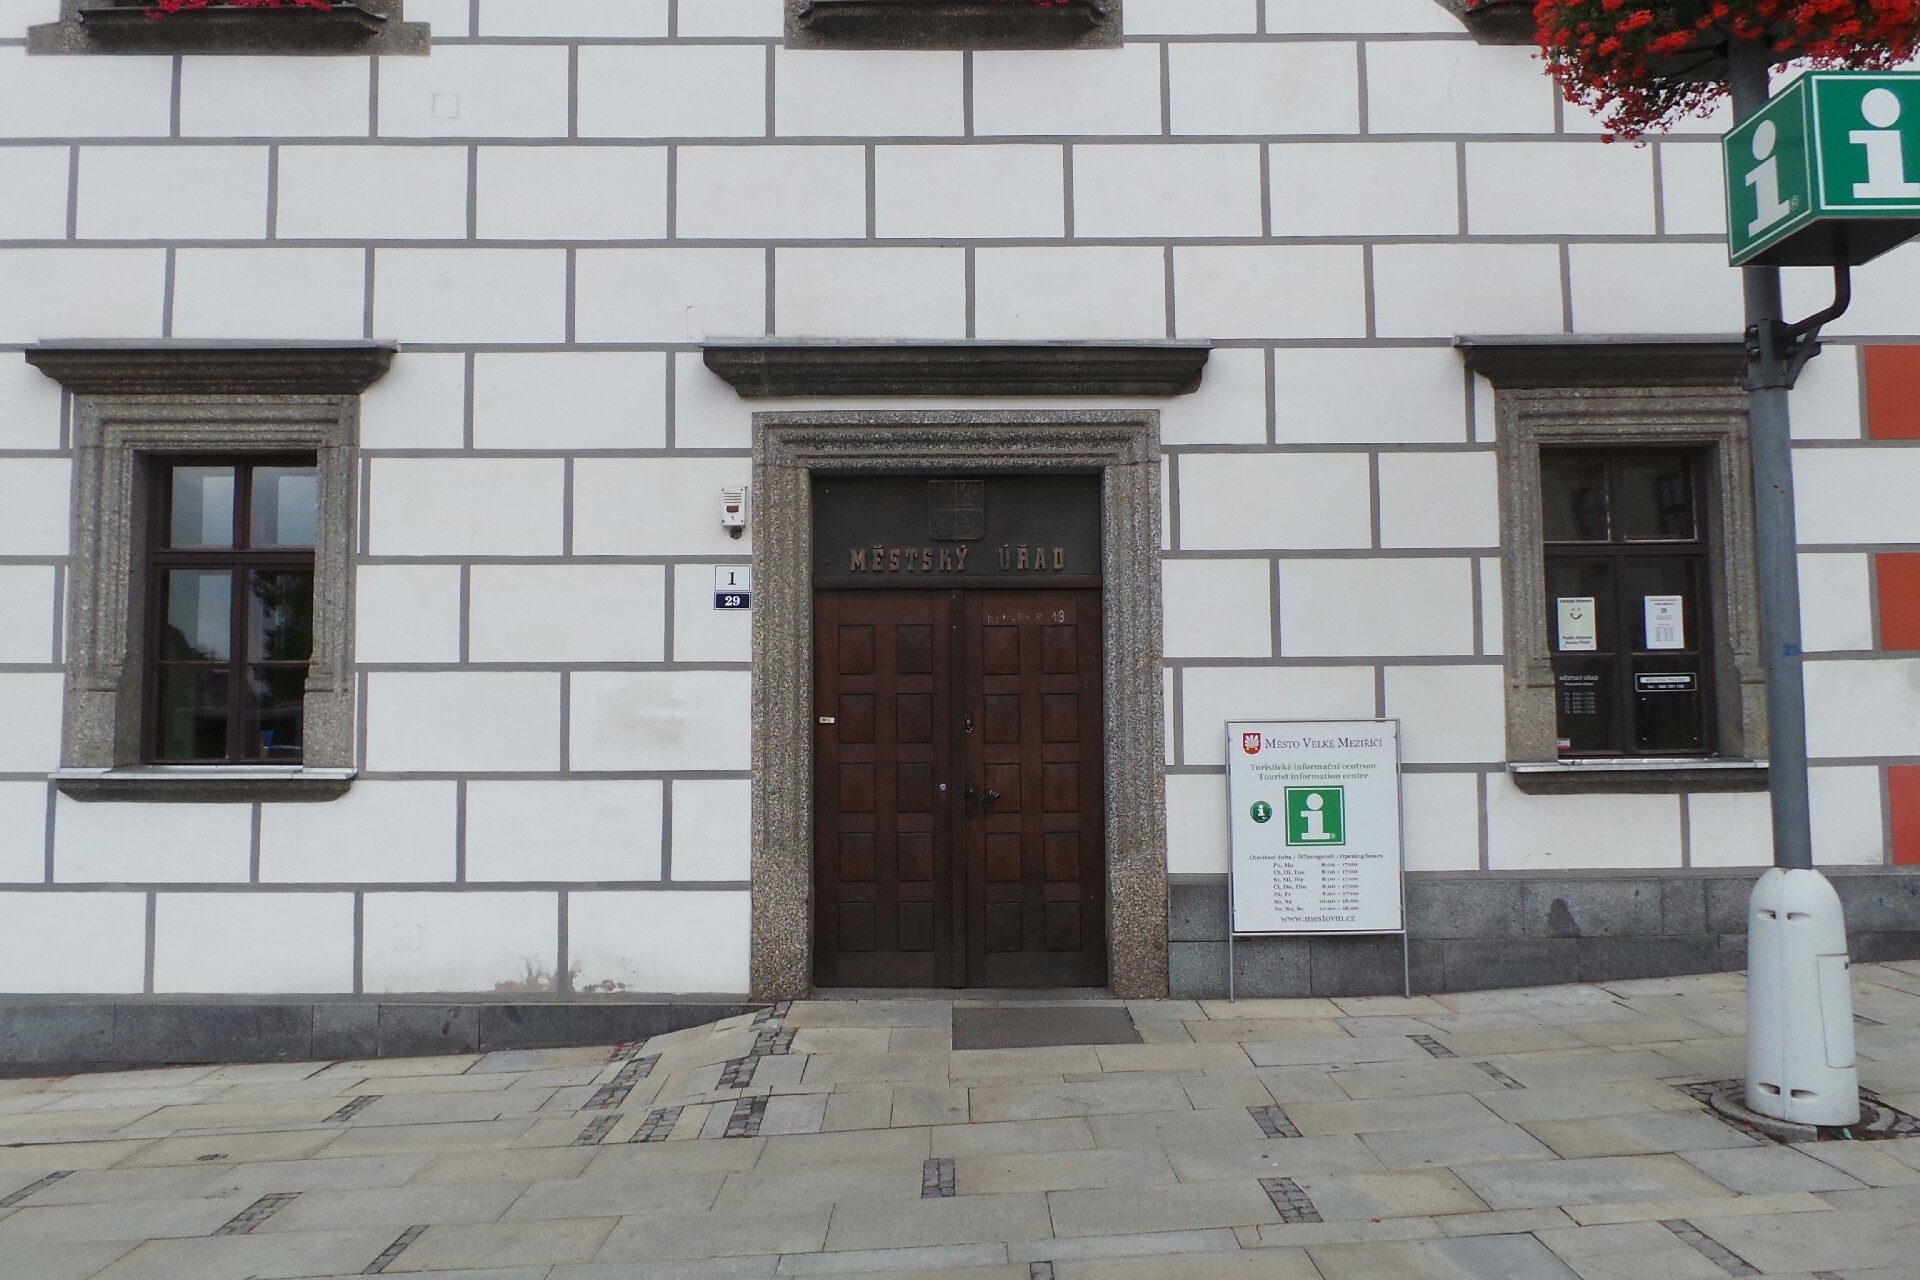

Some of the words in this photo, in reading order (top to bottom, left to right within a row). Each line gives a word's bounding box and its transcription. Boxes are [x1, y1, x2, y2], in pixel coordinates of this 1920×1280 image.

[850, 544, 968, 572] MĚSTSKÝ
[999, 544, 1065, 571] ÚŘAD
[728, 571, 736, 586] 1
[724, 595, 741, 607] 29
[1265, 738, 1300, 749] MĚSTO
[1303, 738, 1335, 748] VELKÉ
[1338, 737, 1382, 748] MEZIŘÍČÍ
[1250, 763, 1292, 771] Turistické
[1290, 772, 1341, 780] information
[1280, 914, 1355, 923] www.mestovm.cz
